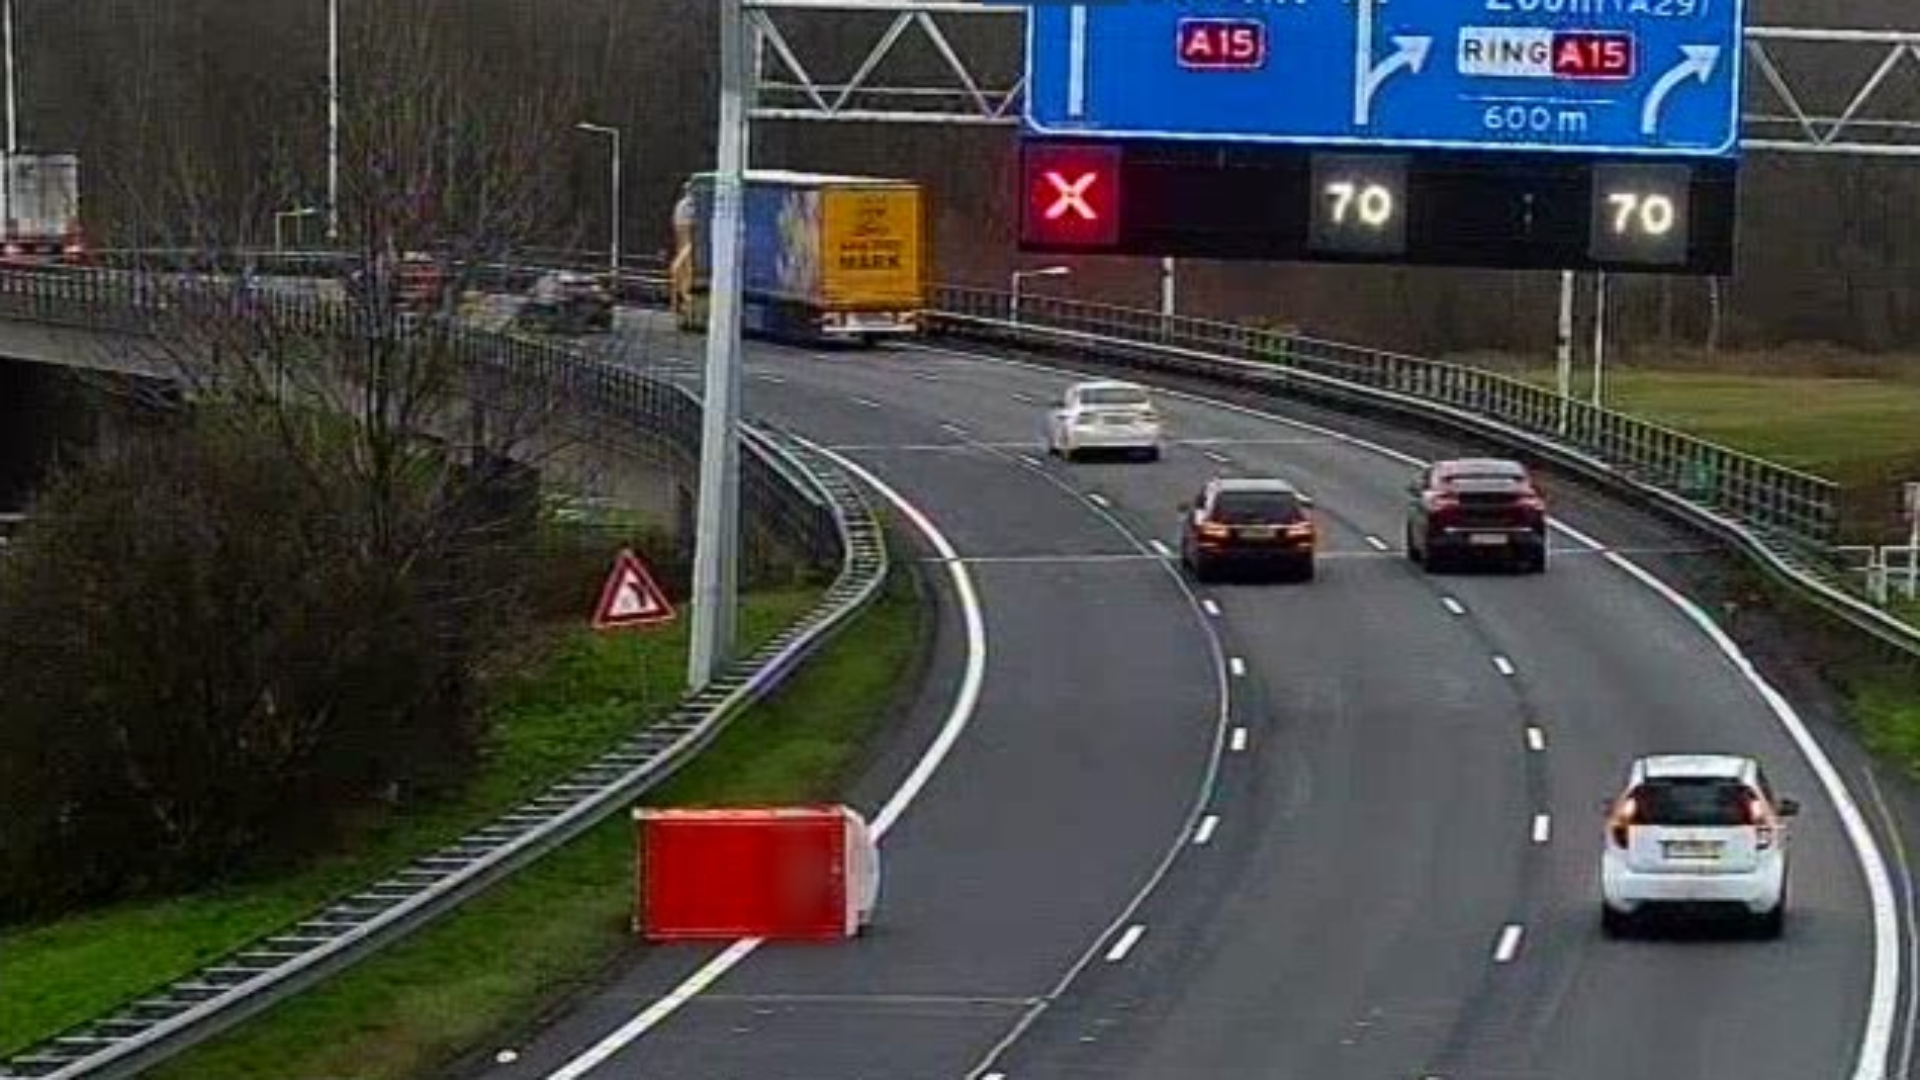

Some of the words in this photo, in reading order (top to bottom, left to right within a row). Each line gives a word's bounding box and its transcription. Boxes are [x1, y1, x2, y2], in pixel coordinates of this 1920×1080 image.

[1185, 29, 1254, 58] A15
[1464, 39, 1548, 64] RING
[1556, 41, 1627, 68] A15
[1484, 106, 1550, 130] 600
[1558, 111, 1587, 131] m
[1326, 184, 1392, 225] 70
[1609, 194, 1674, 233] 70
